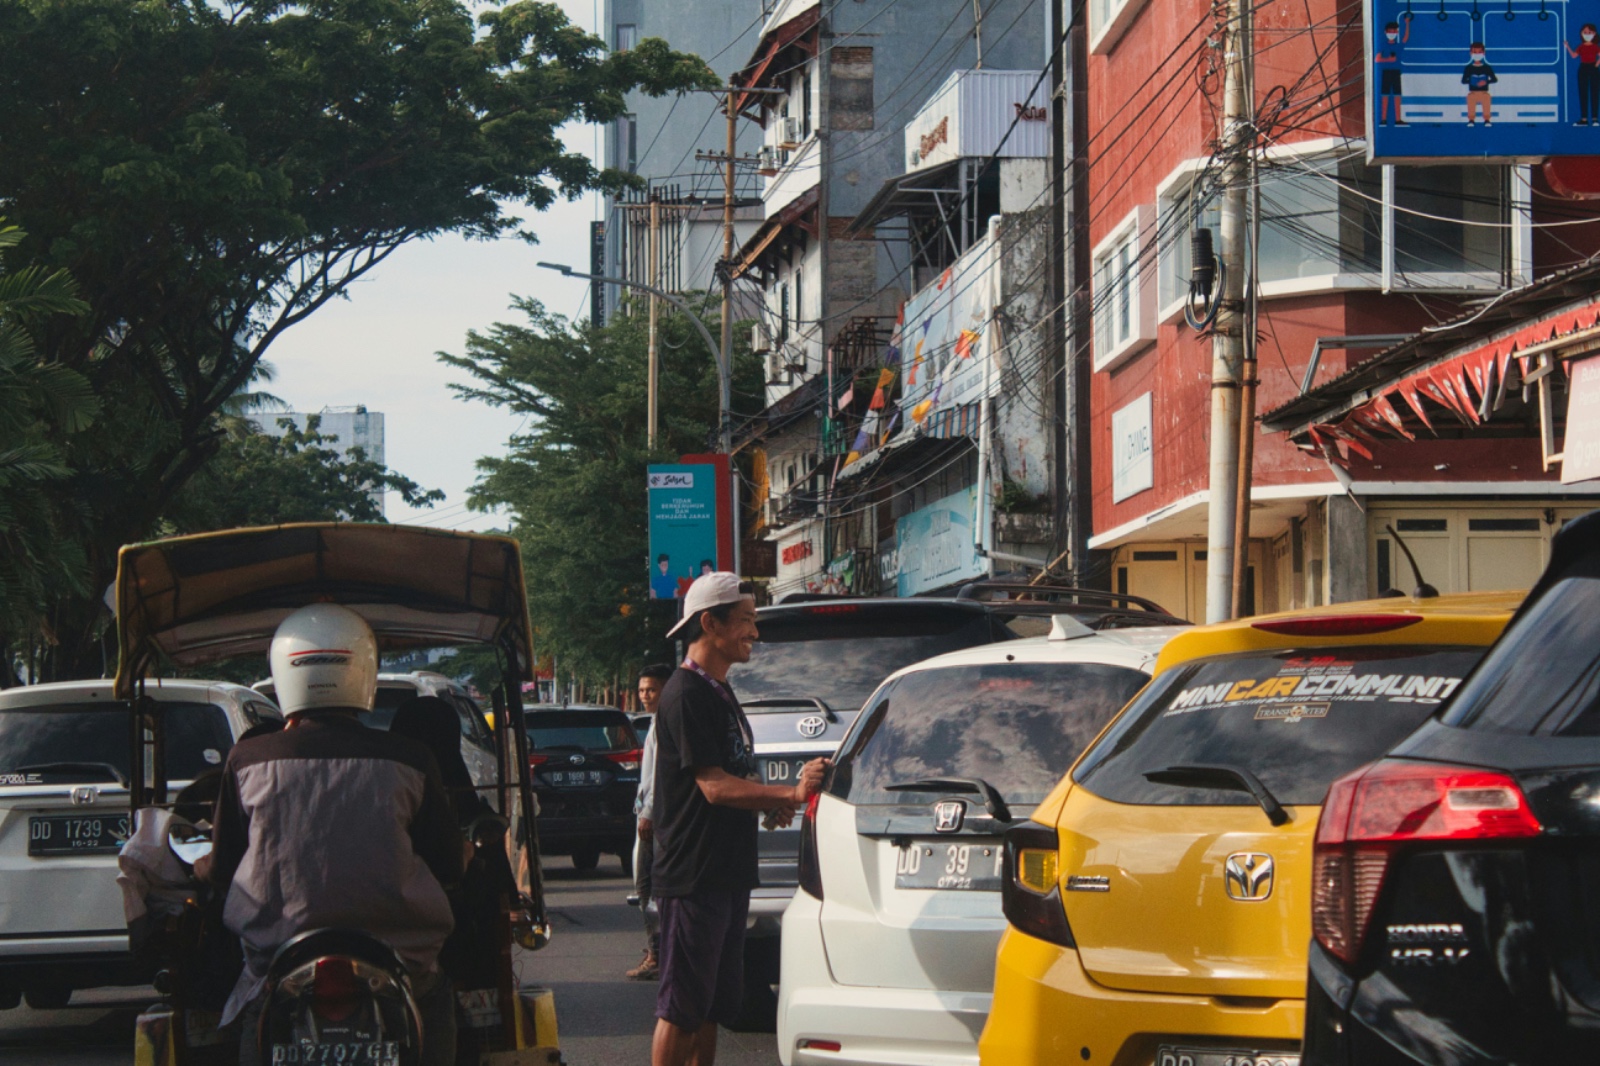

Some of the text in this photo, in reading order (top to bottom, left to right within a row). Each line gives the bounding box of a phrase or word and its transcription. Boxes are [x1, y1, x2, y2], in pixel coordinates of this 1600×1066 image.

[768, 760, 789, 780] DD
[31, 821, 52, 840] DD
[65, 819, 103, 839] 1739
[945, 844, 970, 875] 39
[1386, 924, 1467, 942] HONDA
